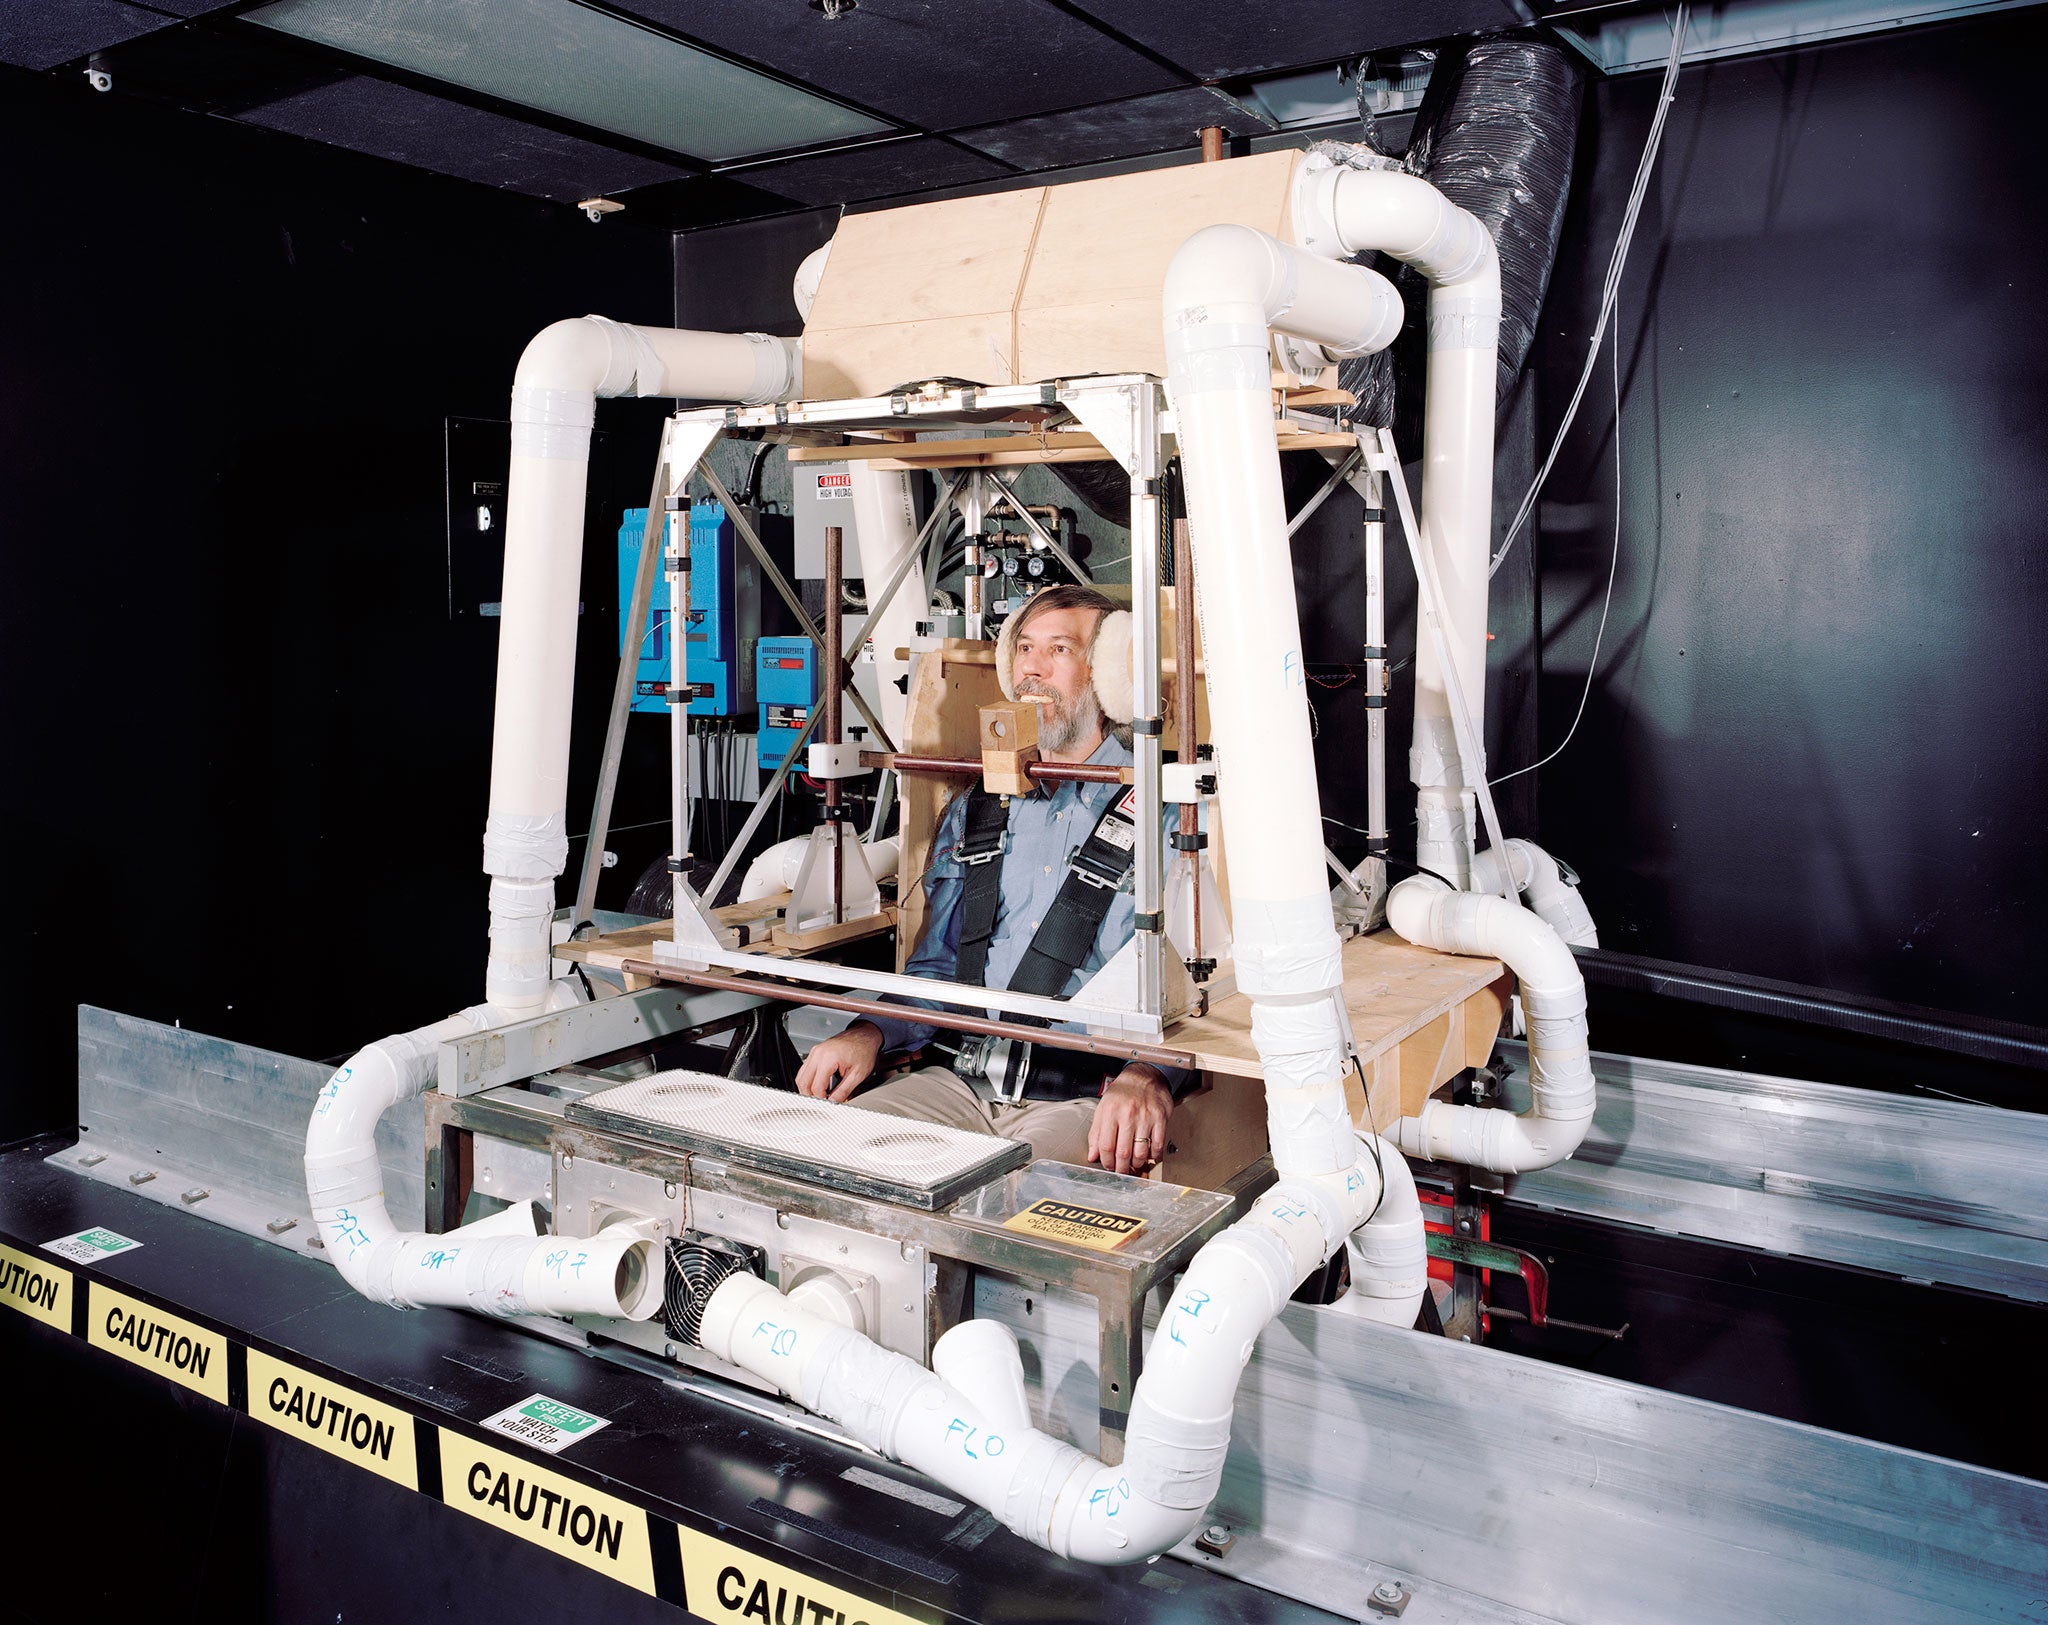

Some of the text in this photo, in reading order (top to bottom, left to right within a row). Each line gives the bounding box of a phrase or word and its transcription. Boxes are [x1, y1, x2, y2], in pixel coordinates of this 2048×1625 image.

[820, 488, 832, 498] HIGH
[1027, 1218, 1106, 1239] OUT OF MOVING
[1038, 1203, 1133, 1231] CAUTION
[1040, 1216, 1105, 1234] KEEP HANDS
[1031, 1224, 1091, 1240] MACHINERY
[105, 1307, 211, 1379] CAUTION
[752, 1321, 797, 1356] FLO
[268, 1377, 395, 1461] CAUTION
[518, 1416, 560, 1435] WATCH
[534, 1401, 593, 1426] SAFETY
[538, 1413, 566, 1426] FIRST
[497, 1418, 559, 1445] YOUR STEP
[944, 1418, 1005, 1460] FLO
[467, 1461, 624, 1561] CAUTION
[1088, 1477, 1131, 1520] FLO
